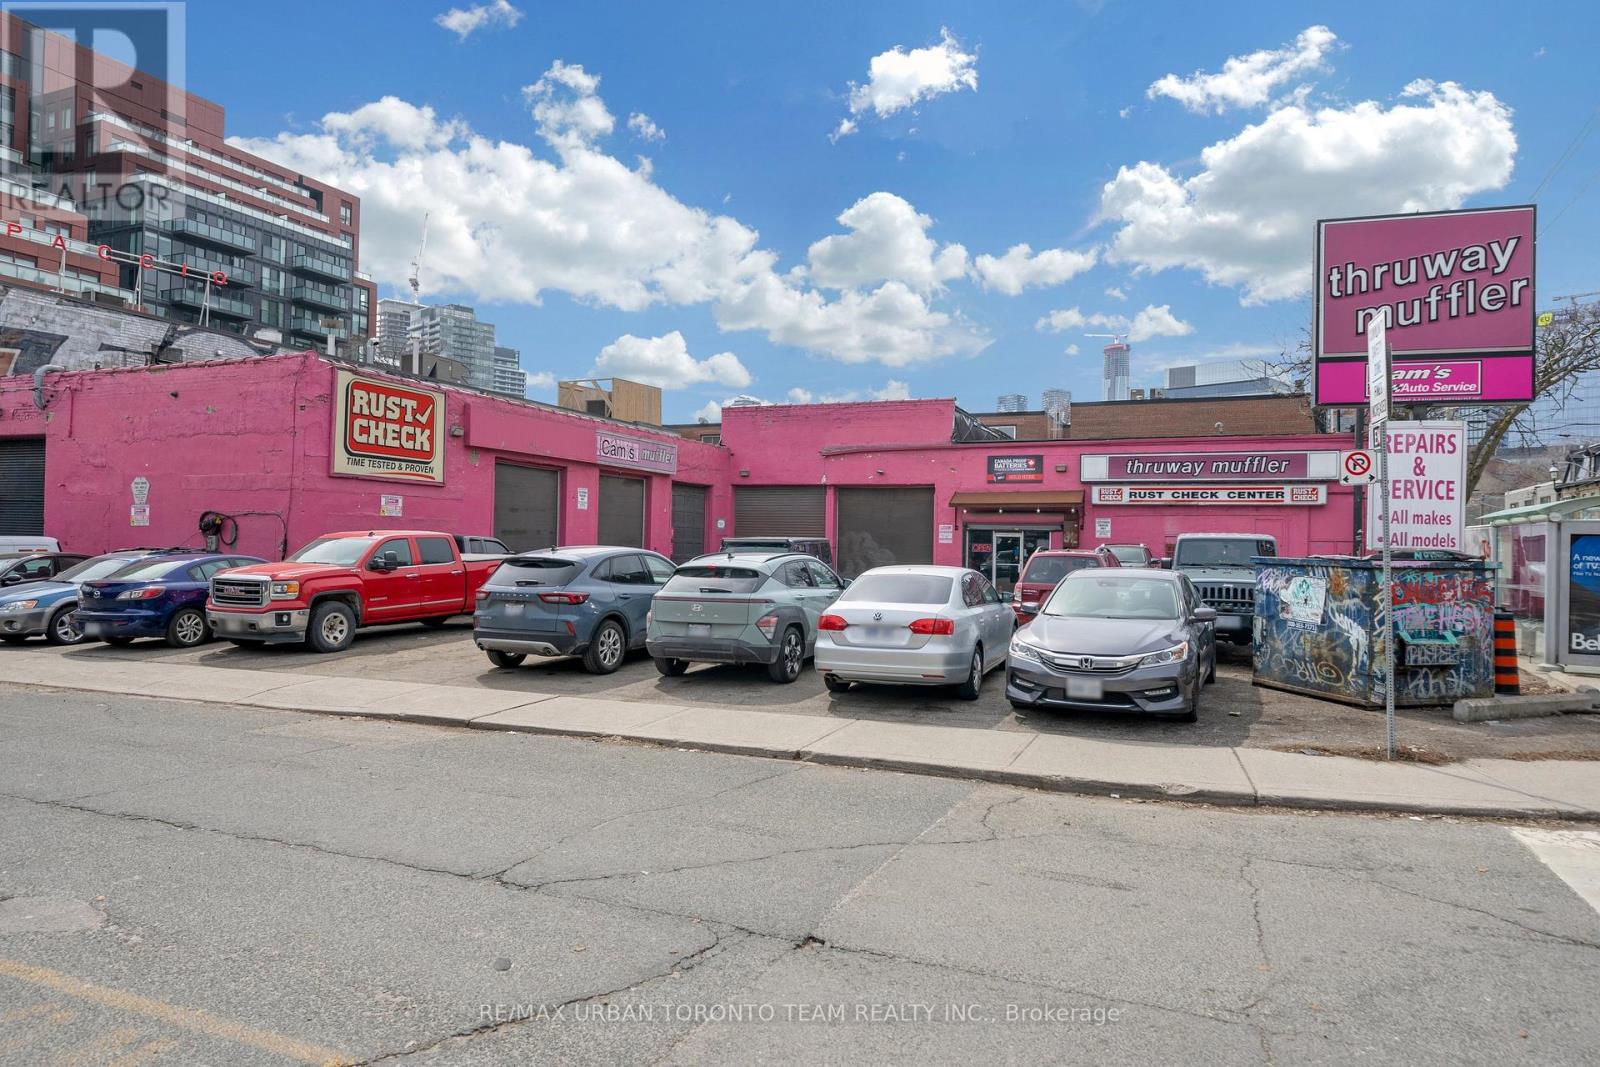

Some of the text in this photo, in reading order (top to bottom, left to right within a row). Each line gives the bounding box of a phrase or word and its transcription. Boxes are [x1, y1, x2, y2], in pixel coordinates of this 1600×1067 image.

[1328, 235, 1522, 299] thruway
[1355, 277, 1530, 336] muffler
[1390, 365, 1453, 380] am's
[1400, 381, 1477, 393] Auto Service
[352, 389, 417, 423] RUST
[353, 418, 431, 452] CHECK
[1385, 433, 1457, 454] REPAIRS
[602, 439, 674, 464] Cam's muffler
[346, 457, 434, 474] TIME TESTED & PROVEN
[1125, 456, 1290, 477] thruway muffler
[1413, 456, 1426, 477] &
[1129, 491, 1285, 499] RUST CHECK CENTER
[1387, 479, 1456, 500] ERVICE
[1390, 509, 1452, 526] All makes
[1390, 532, 1457, 548] All models
[1573, 553, 1580, 561] A
